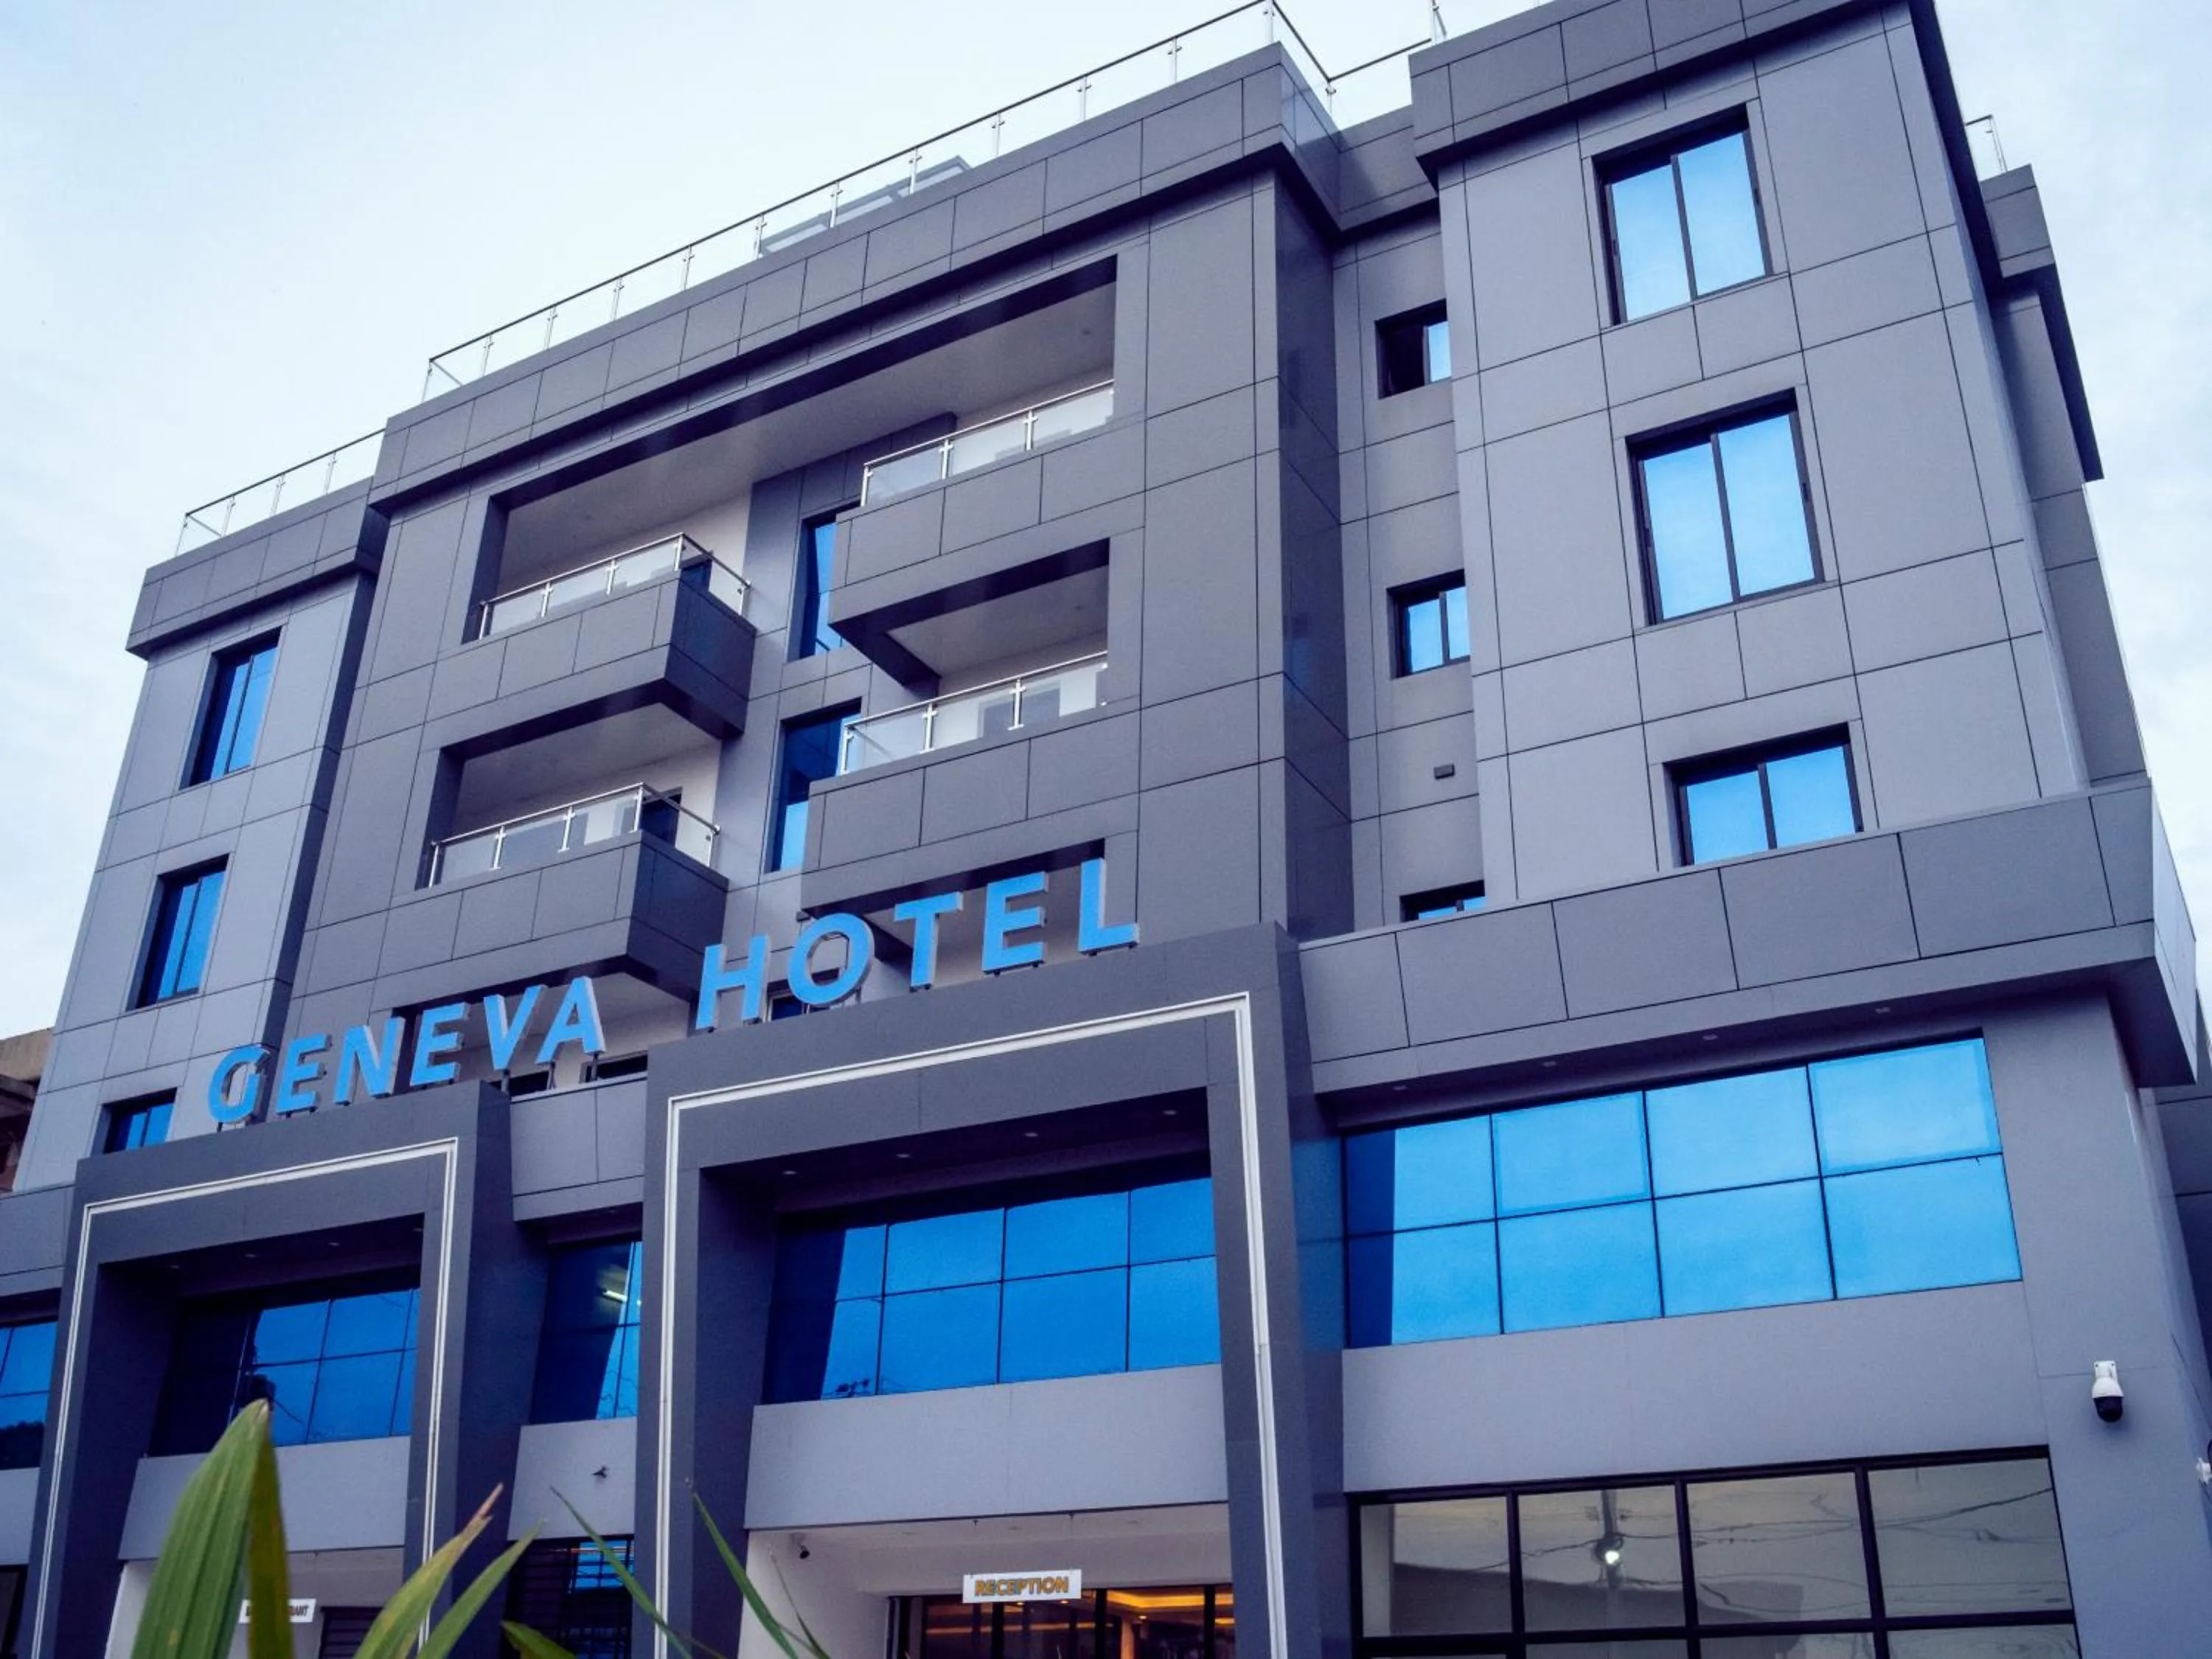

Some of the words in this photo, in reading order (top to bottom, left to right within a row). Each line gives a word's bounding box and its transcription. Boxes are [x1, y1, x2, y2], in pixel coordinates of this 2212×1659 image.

[207, 975, 607, 1123] GENEVA
[695, 857, 1140, 1030] HOTEL
[974, 1576, 1068, 1596] RECEPTION
